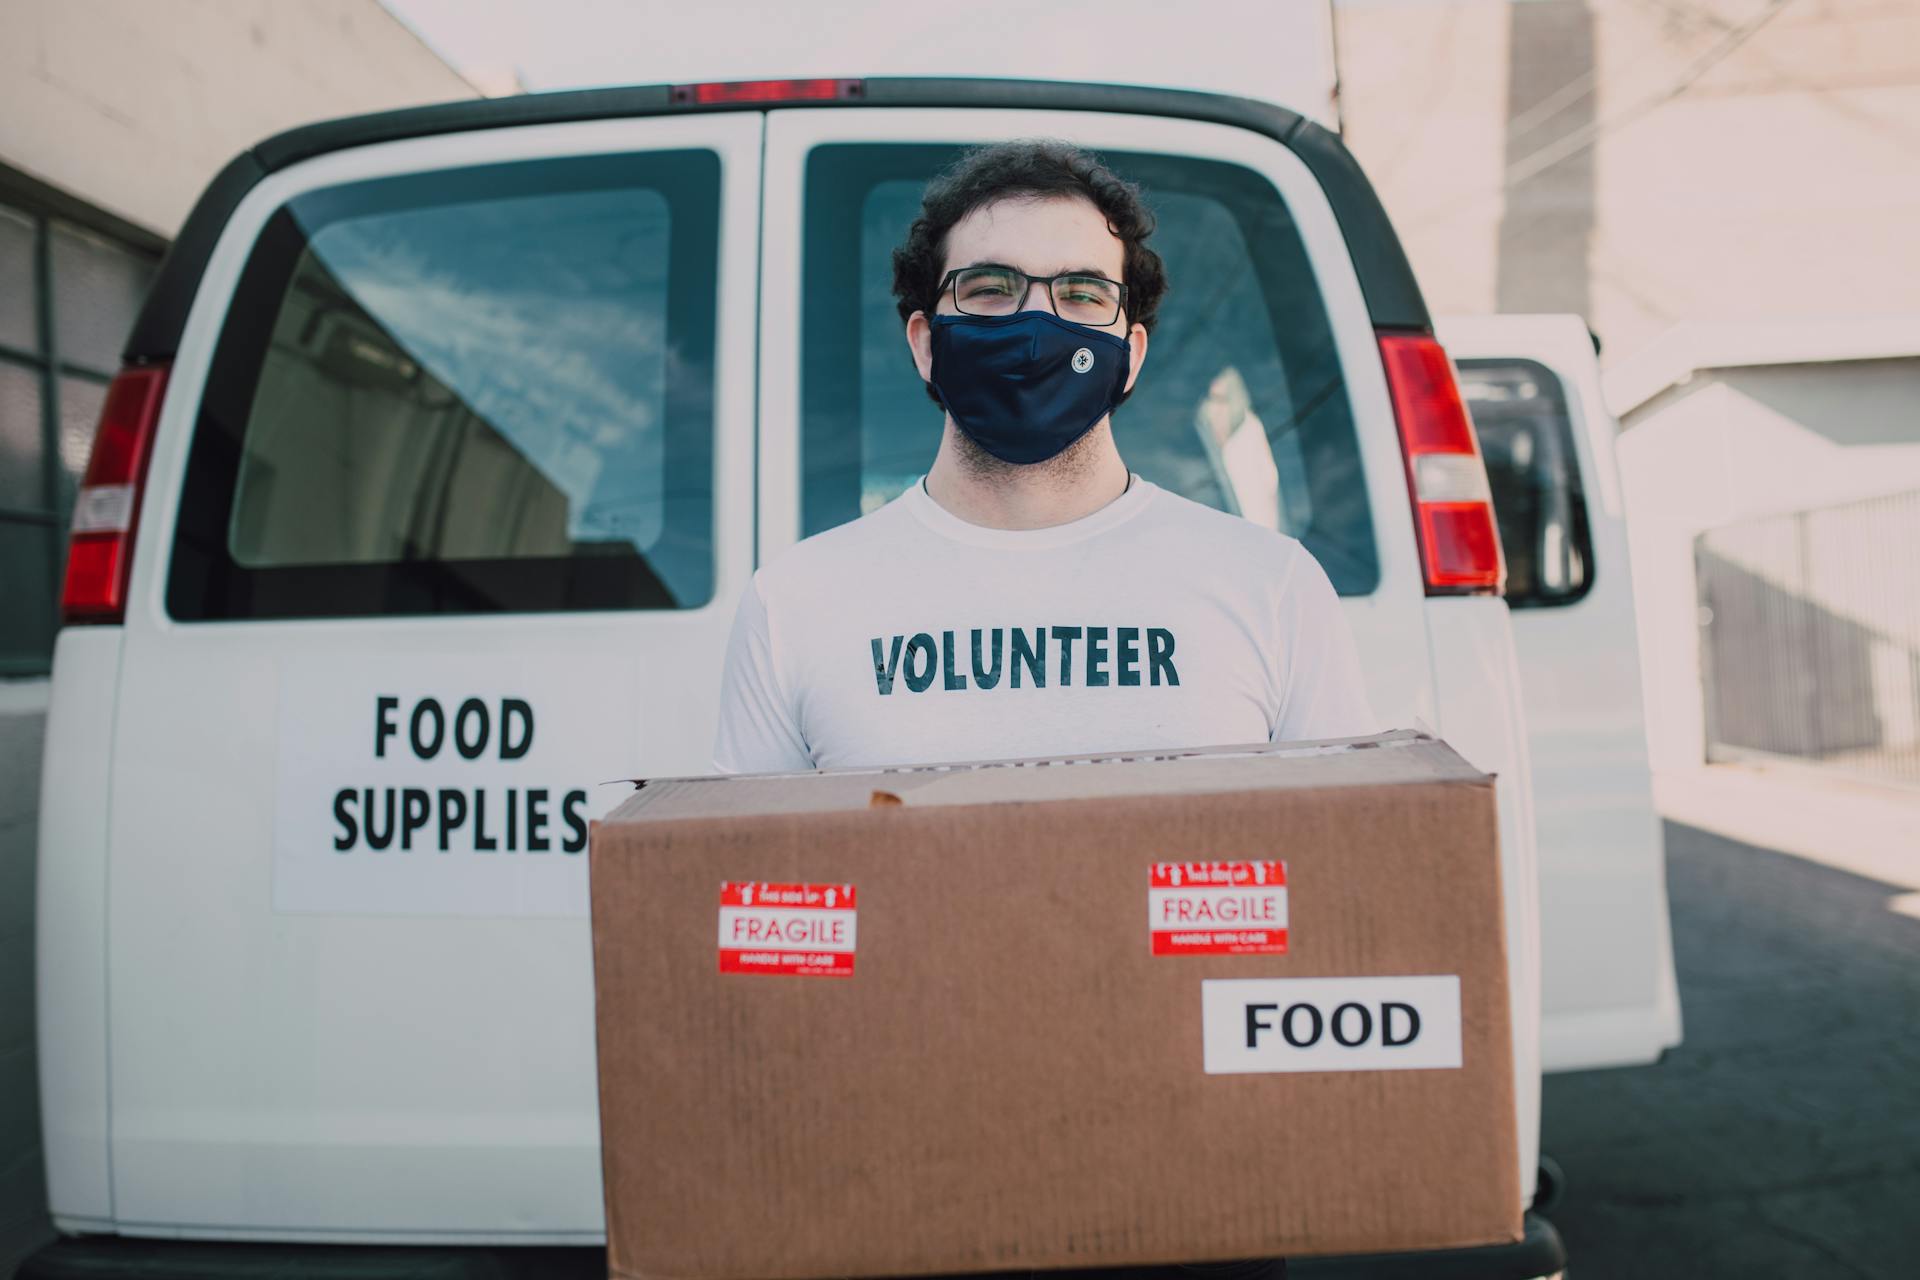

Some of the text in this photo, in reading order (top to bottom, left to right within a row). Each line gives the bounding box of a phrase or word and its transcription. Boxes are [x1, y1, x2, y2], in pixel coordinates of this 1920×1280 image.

[871, 626, 1180, 695] VOLUNTEER
[375, 697, 534, 760] FOOD
[334, 788, 588, 853] SUPPLIES
[733, 917, 845, 944] FRAGILE
[1163, 896, 1276, 922] FRAGILE
[1246, 1002, 1421, 1048] FOOD
